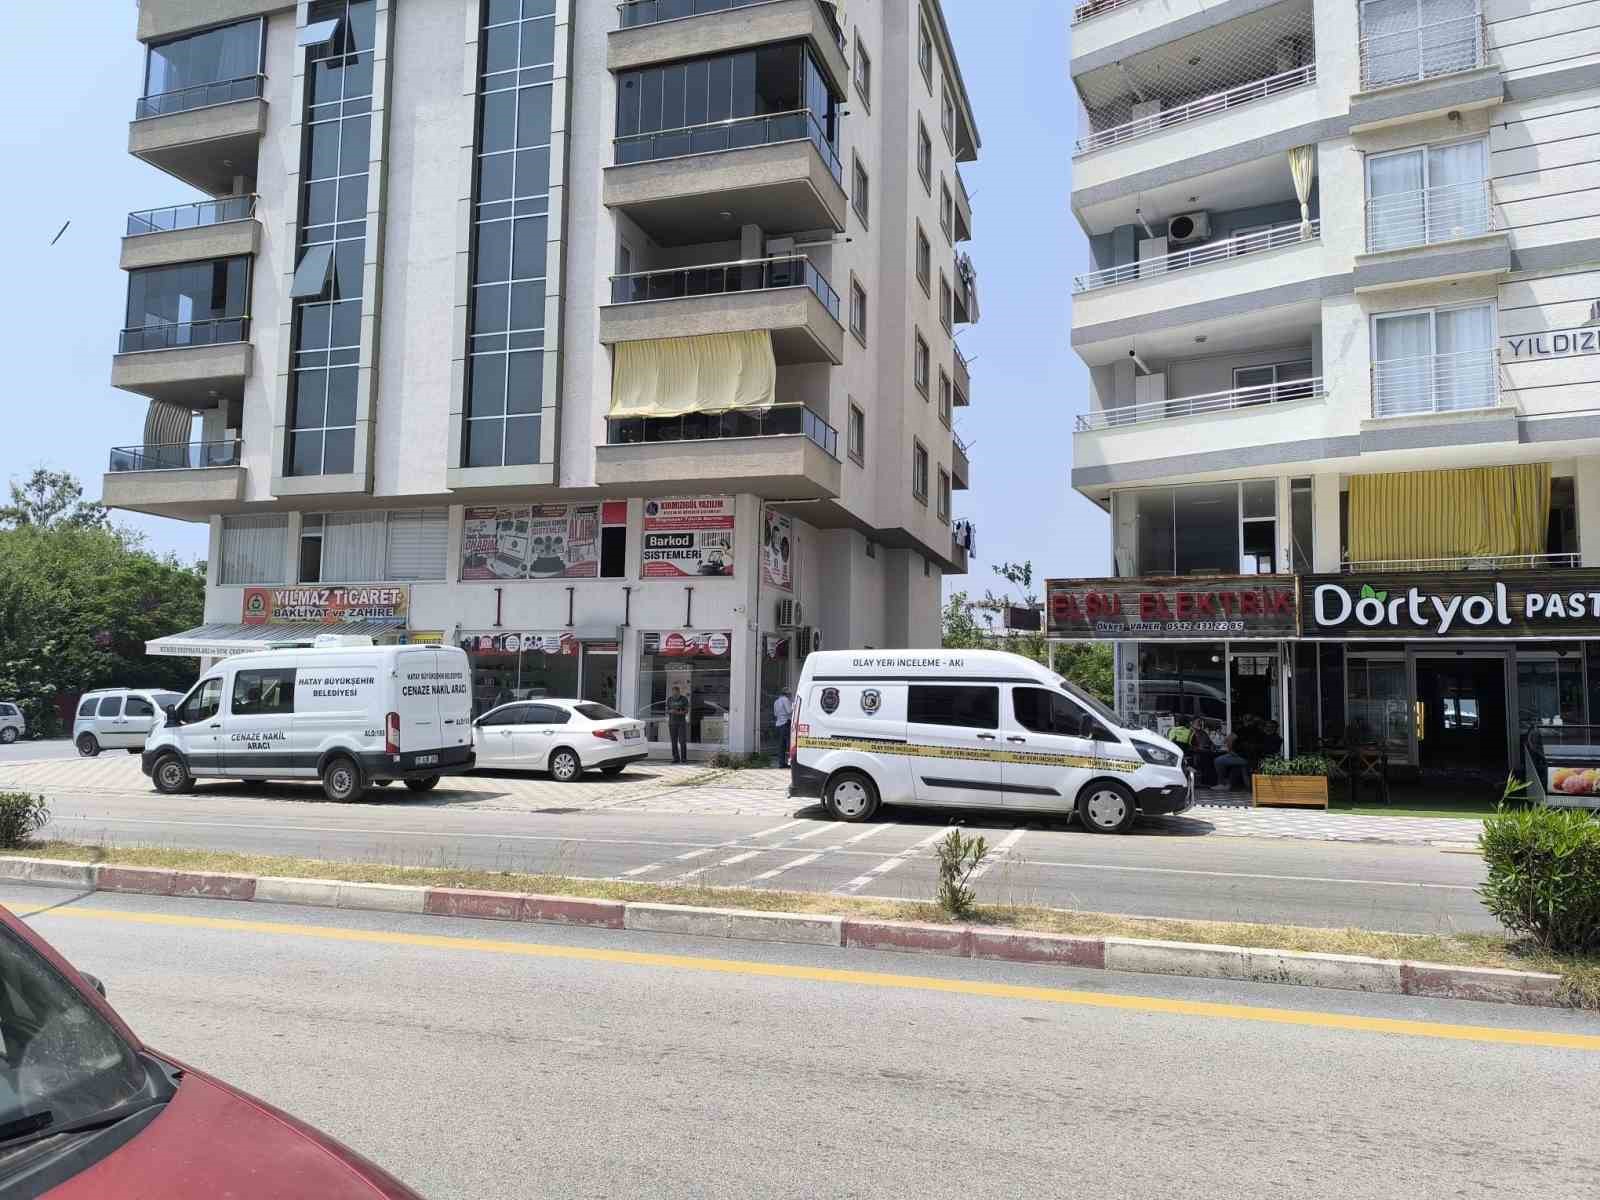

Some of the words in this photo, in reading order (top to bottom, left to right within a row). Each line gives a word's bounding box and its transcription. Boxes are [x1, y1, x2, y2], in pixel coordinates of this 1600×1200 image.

[1508, 331, 1600, 356] YILDIZ
[649, 536, 689, 546] Barkod
[275, 590, 329, 606] YILMAZ
[852, 657, 874, 667] OLAY
[298, 678, 322, 686] HATAY
[402, 684, 430, 696] CENAZE
[231, 732, 260, 741] CENAZE
[247, 742, 270, 750] ARACI
